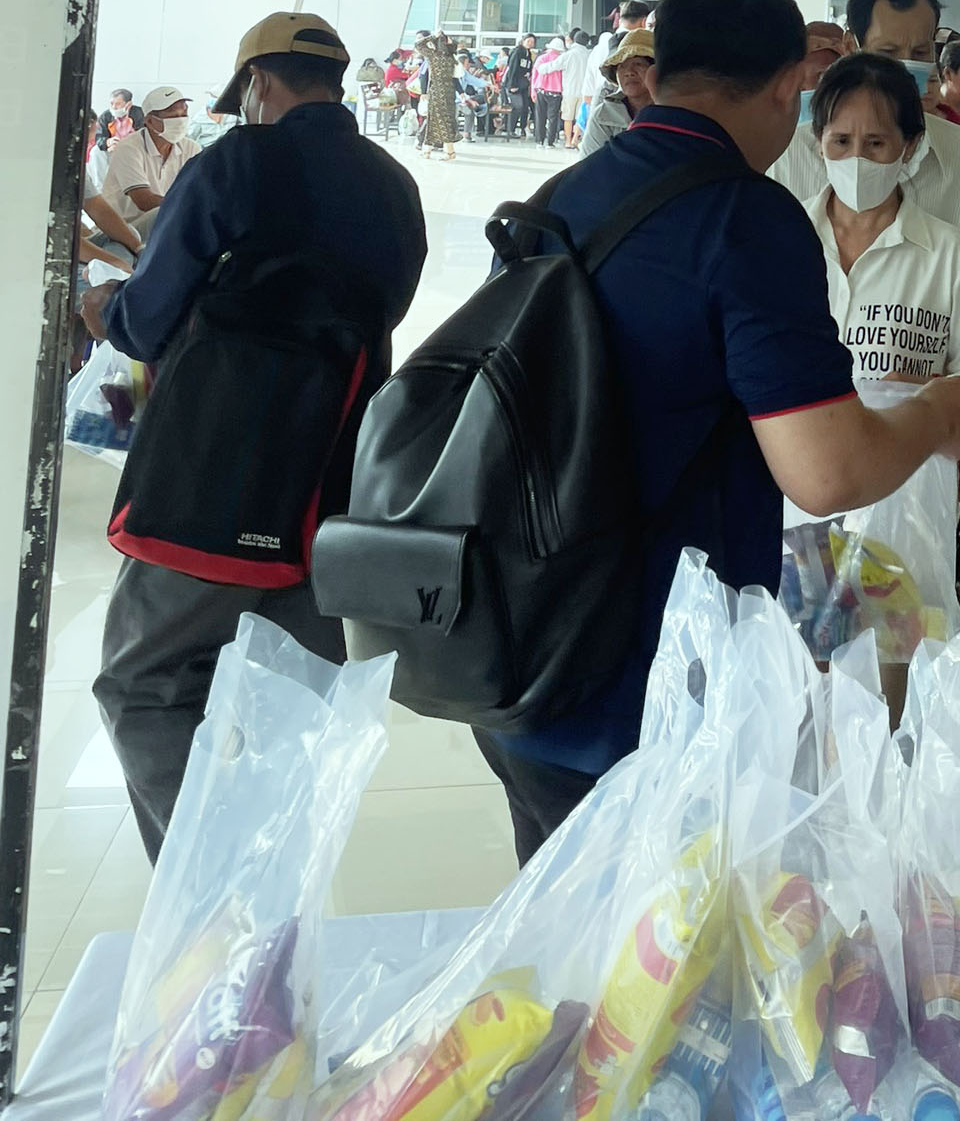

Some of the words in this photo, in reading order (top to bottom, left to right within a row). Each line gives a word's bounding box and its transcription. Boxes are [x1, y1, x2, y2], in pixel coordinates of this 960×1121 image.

[884, 304, 914, 325] YOU
[846, 326, 887, 346] LOVE
[858, 351, 891, 373] YOU
[892, 354, 935, 377] CANNOT
